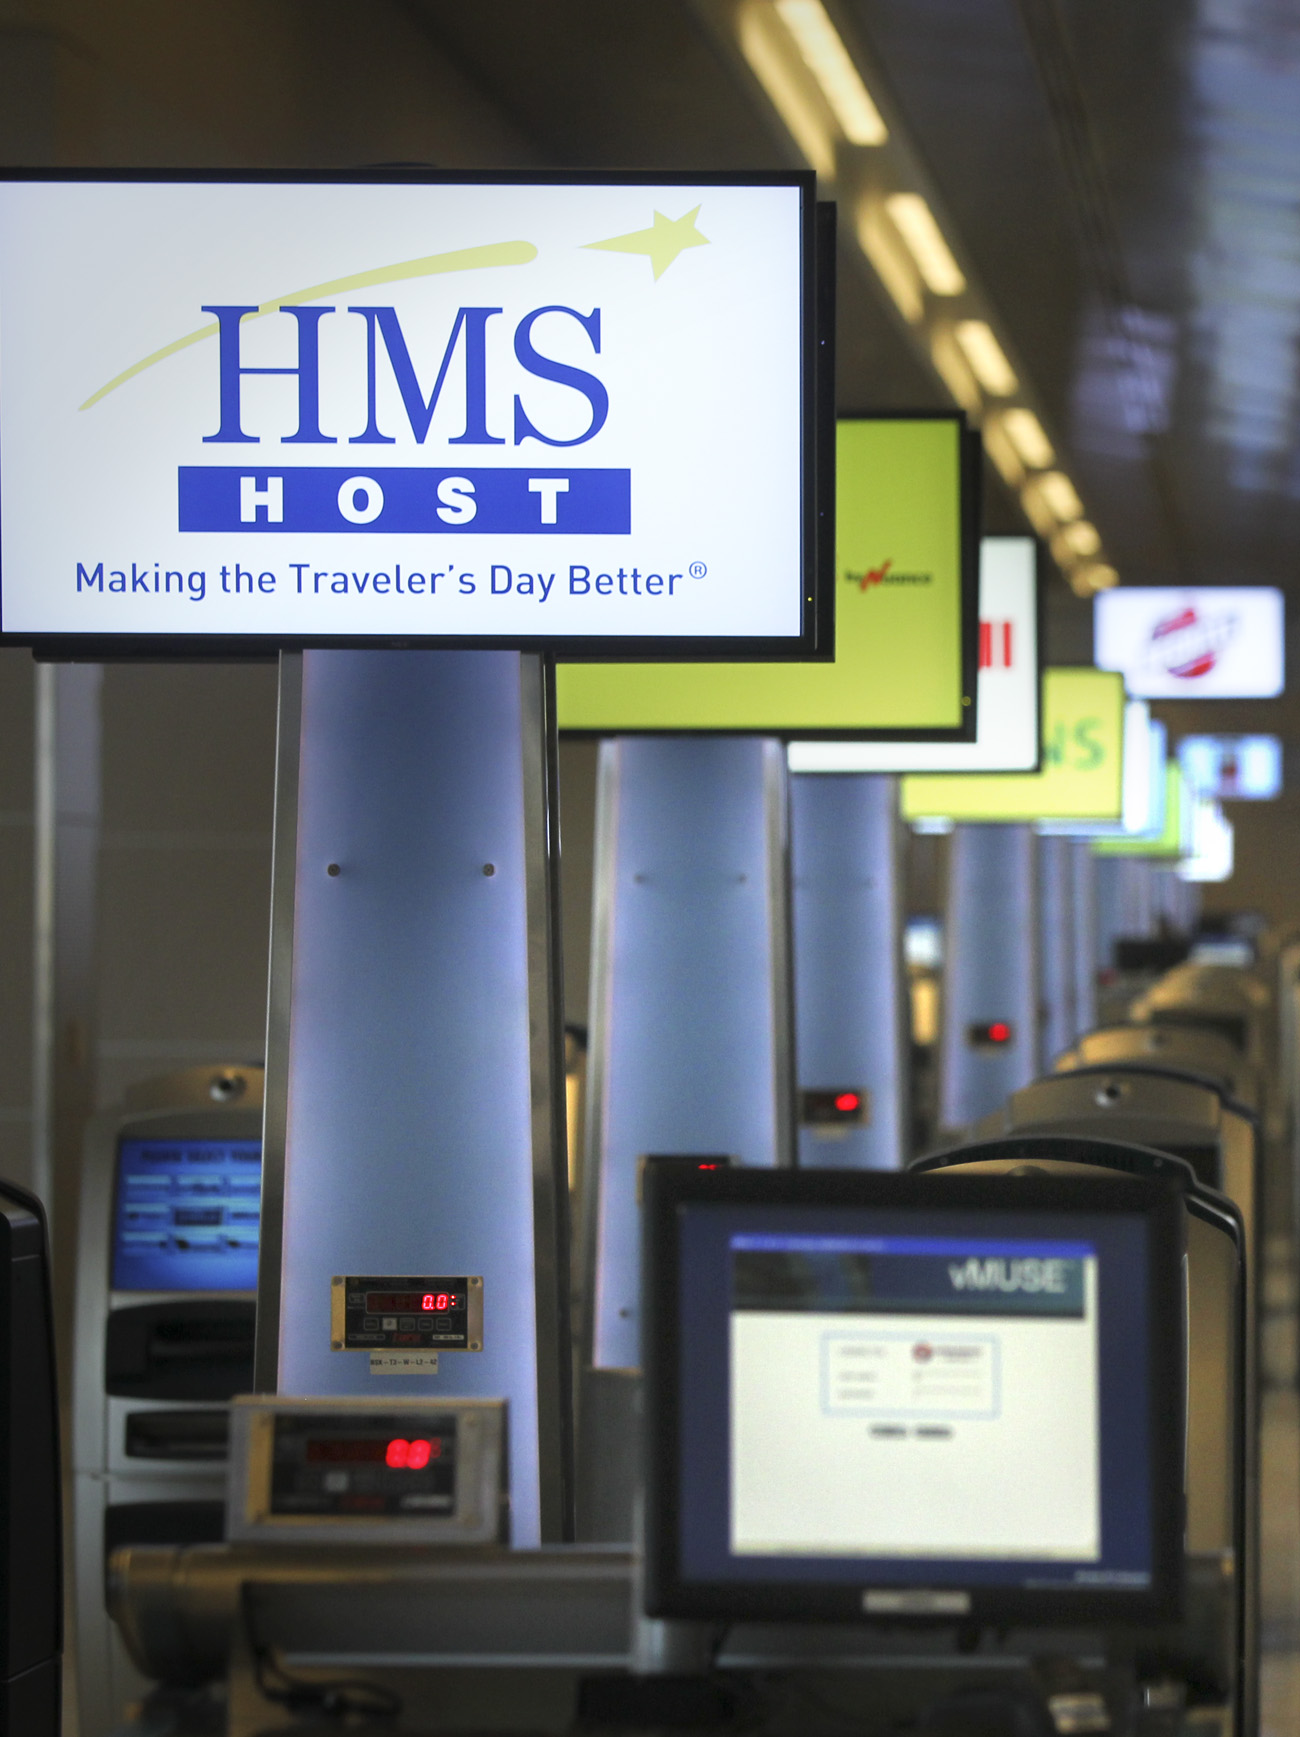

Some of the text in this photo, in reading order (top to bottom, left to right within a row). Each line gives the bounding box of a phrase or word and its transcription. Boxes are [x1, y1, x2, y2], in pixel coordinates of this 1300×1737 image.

[201, 305, 610, 447] HMS
[240, 476, 570, 525] HOST
[76, 562, 207, 602] Making
[219, 563, 277, 594] the
[288, 563, 476, 595] Traveler's
[490, 564, 556, 603] Day
